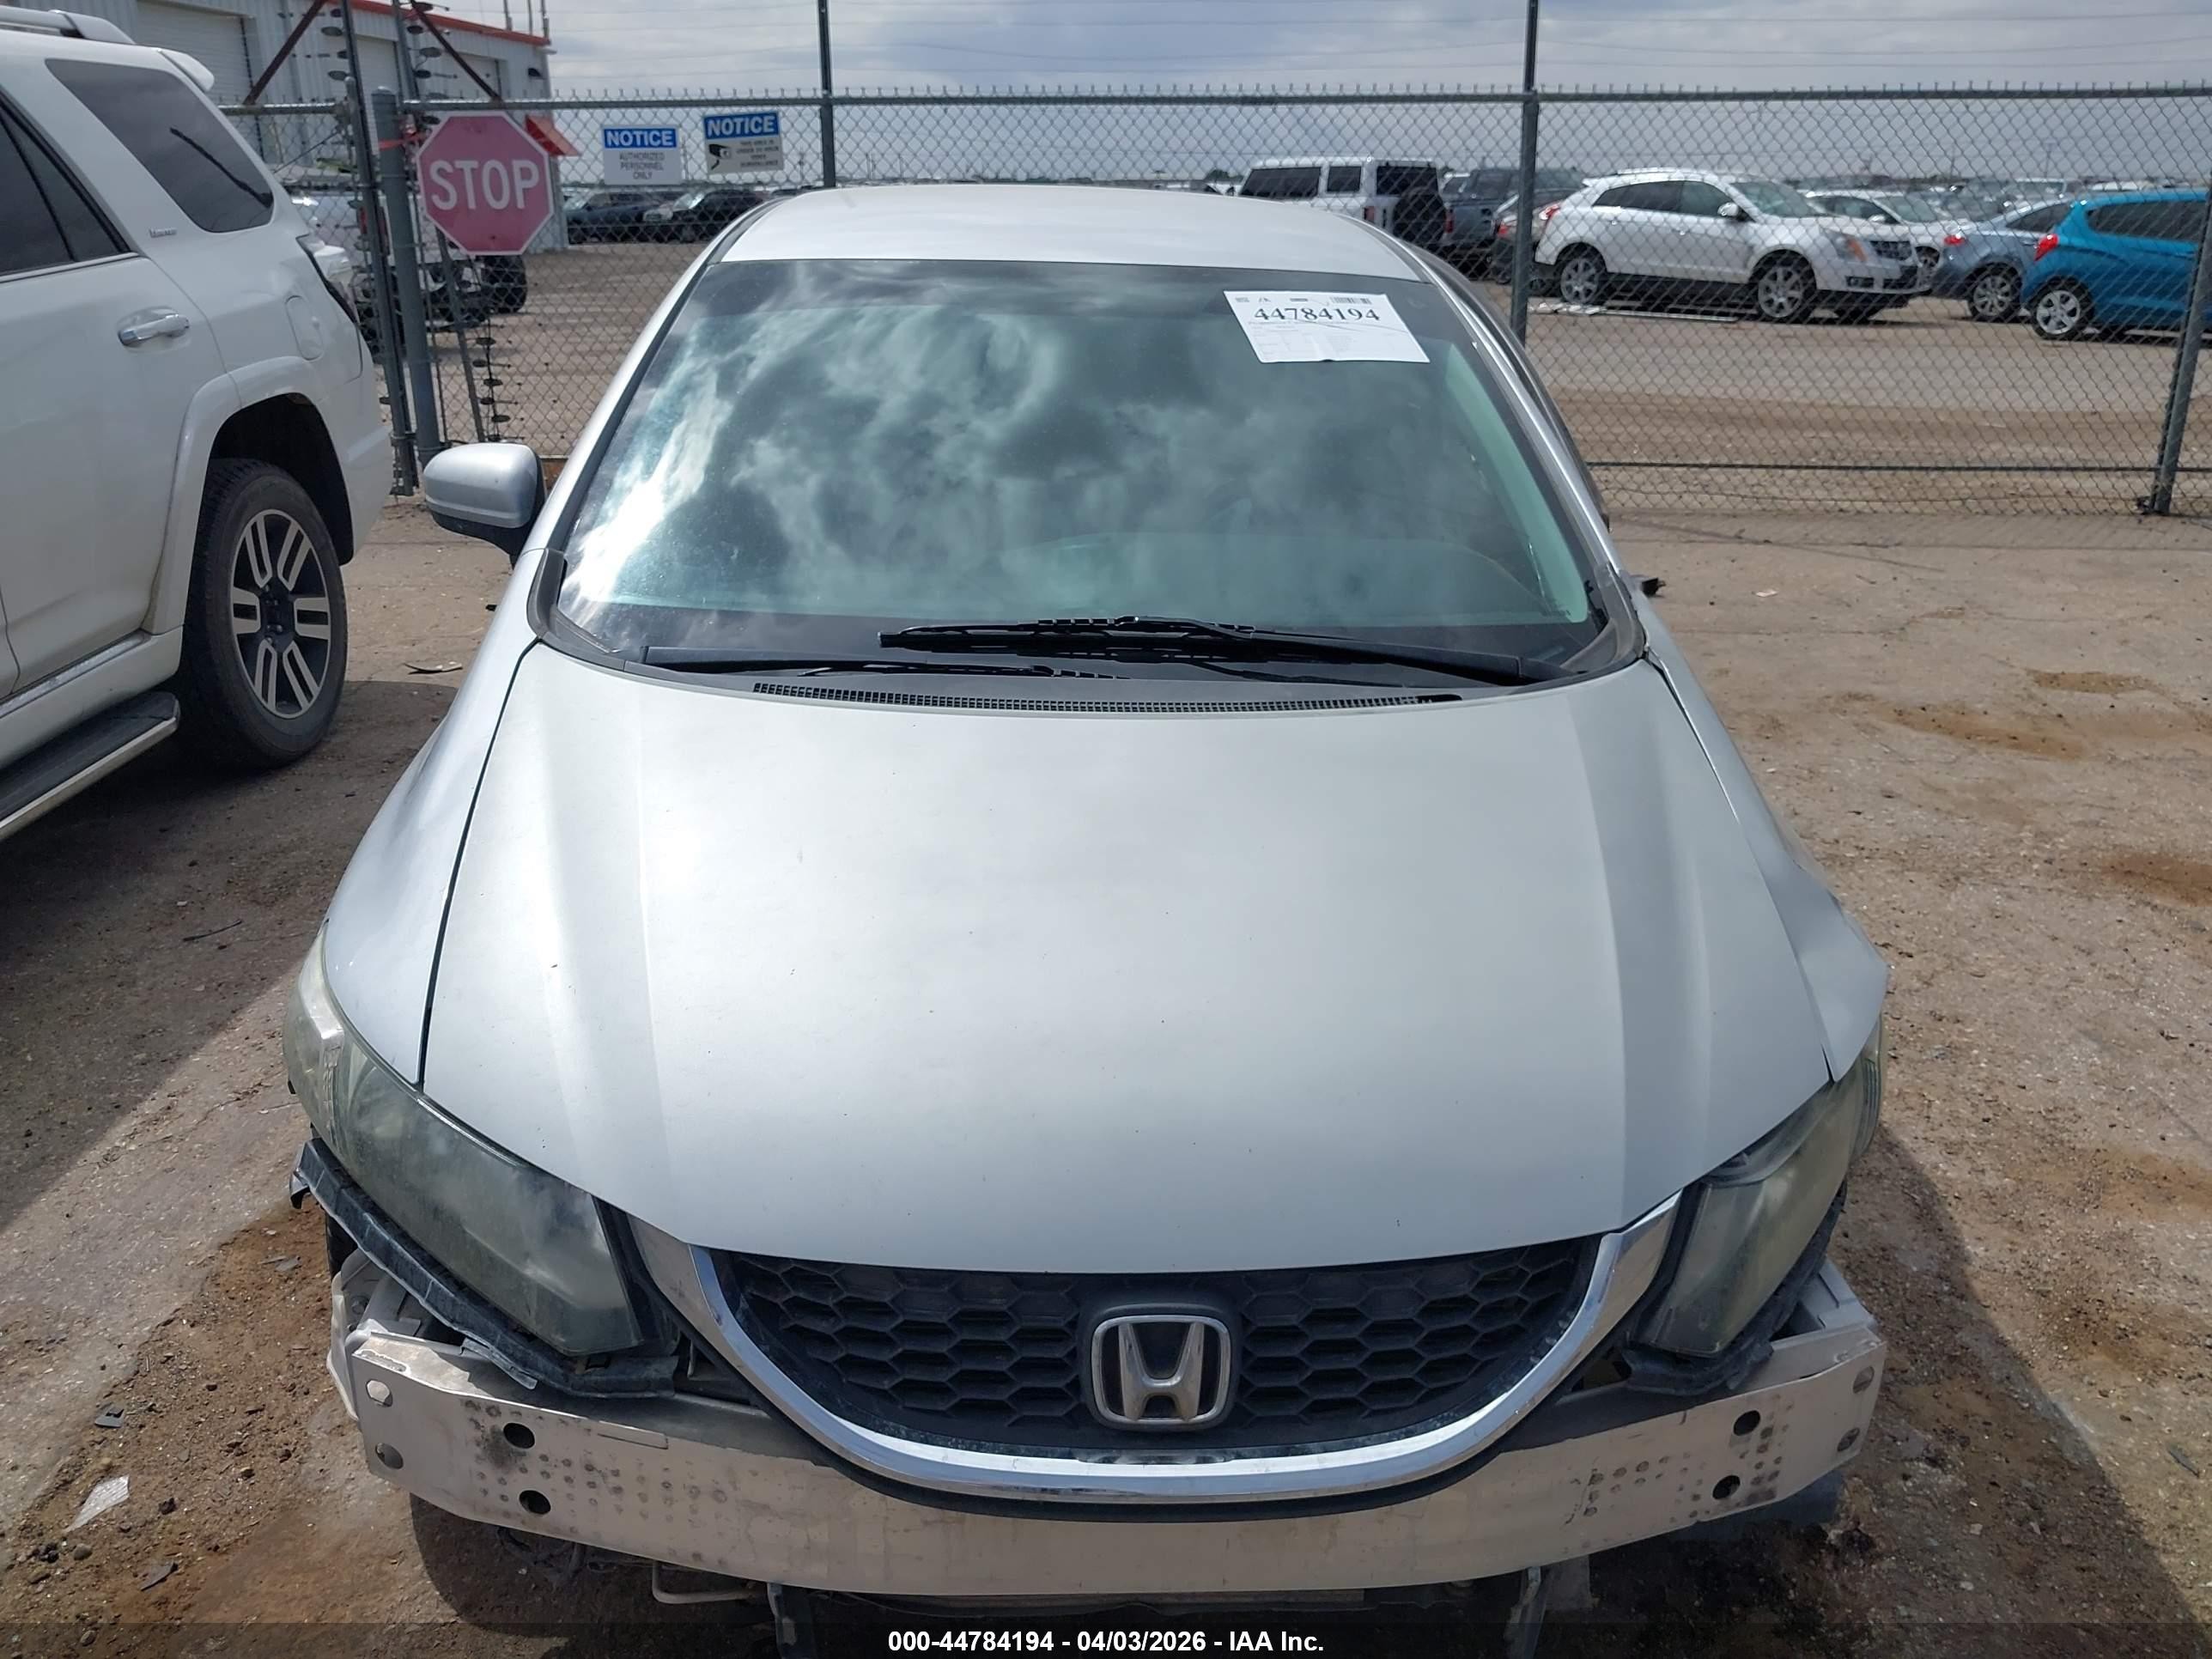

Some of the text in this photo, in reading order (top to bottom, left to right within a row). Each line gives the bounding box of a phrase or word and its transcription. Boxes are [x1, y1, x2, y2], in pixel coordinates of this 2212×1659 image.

[707, 115, 775, 137] NOTICE
[606, 130, 674, 147] NOTICE
[429, 159, 540, 210] STOP
[1254, 307, 1381, 321] 44784194
